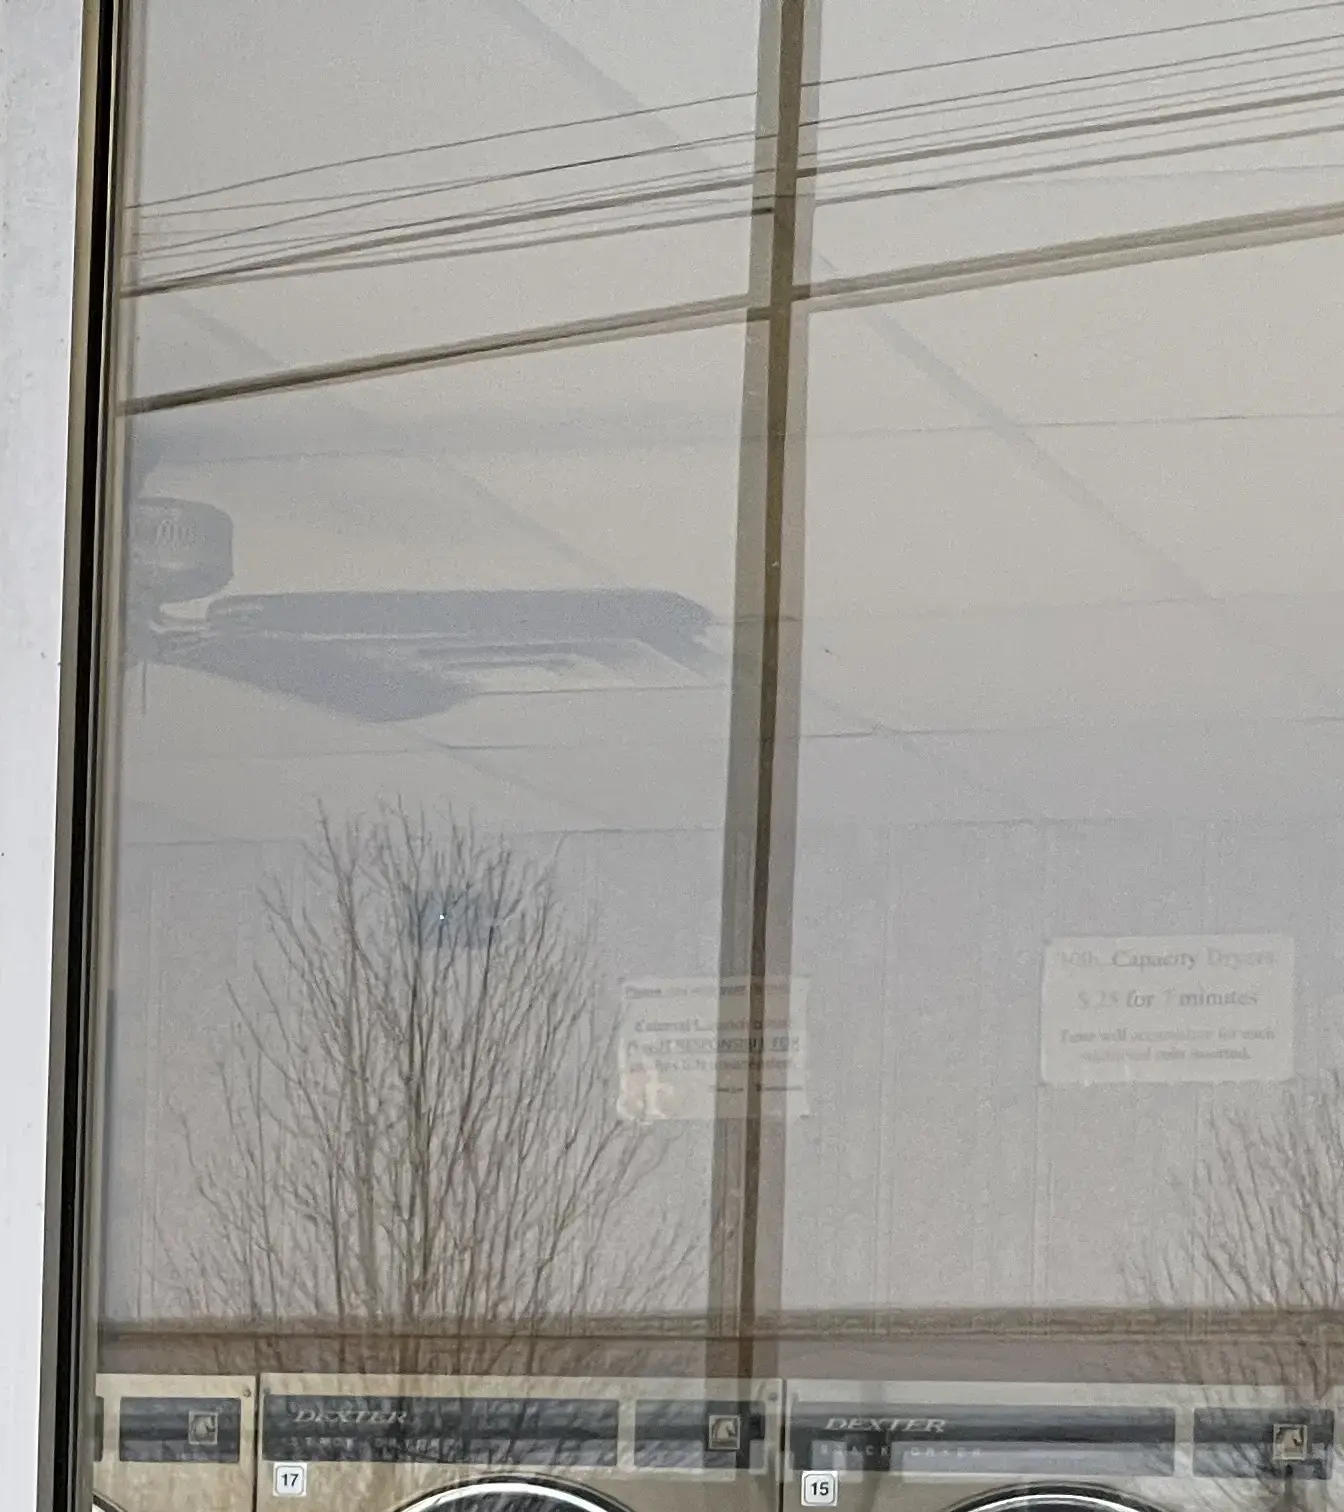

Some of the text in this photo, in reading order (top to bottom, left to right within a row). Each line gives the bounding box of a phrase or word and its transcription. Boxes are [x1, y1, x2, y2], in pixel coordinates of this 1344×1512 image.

[1125, 988, 1155, 1009] for
[1178, 988, 1260, 1008] minutes
[293, 1408, 409, 1425] DEXTER
[824, 1416, 949, 1434] DEXTER
[280, 1472, 300, 1488] 17
[810, 1481, 830, 1497] 15
